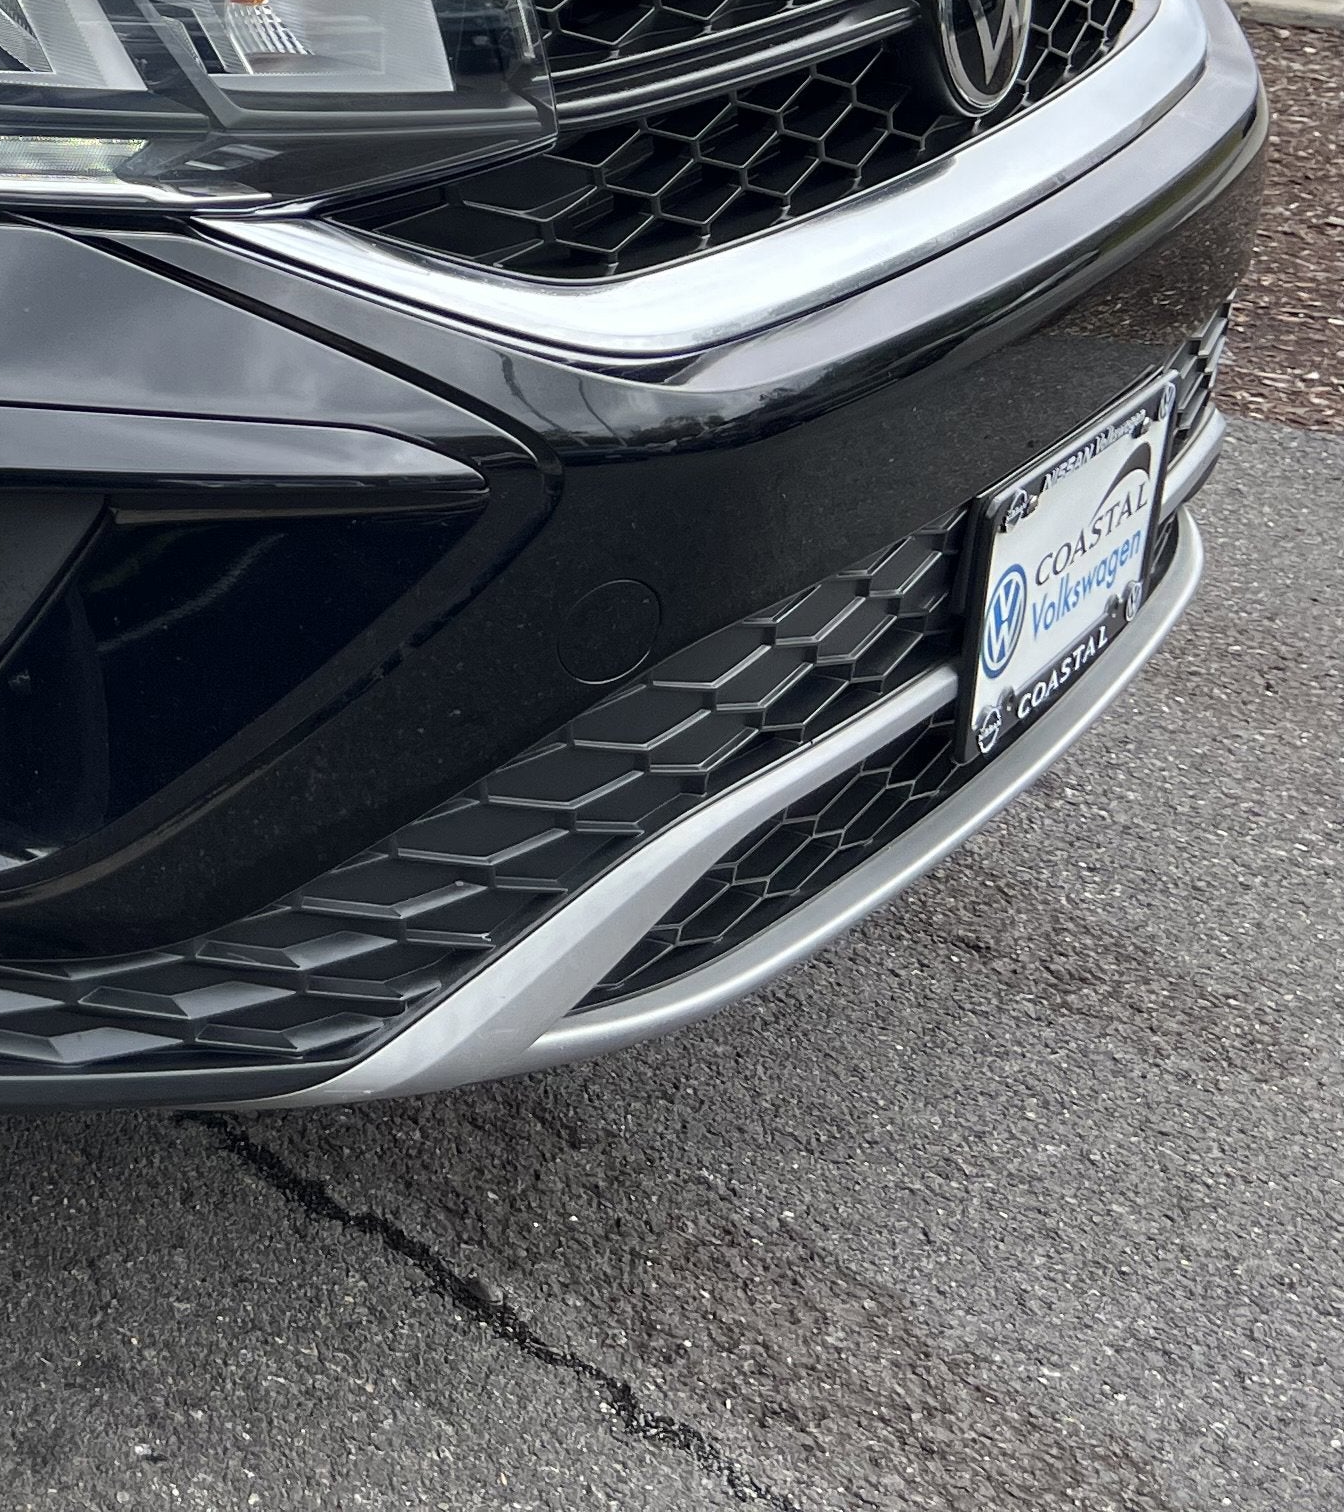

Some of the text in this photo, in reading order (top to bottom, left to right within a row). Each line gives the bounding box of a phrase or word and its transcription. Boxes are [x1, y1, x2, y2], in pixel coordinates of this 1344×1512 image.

[1043, 442, 1096, 492] NISSAN
[1034, 481, 1150, 586] COASTAL
[1032, 529, 1143, 642] Volkswagen
[1017, 625, 1109, 720] COASTAL
